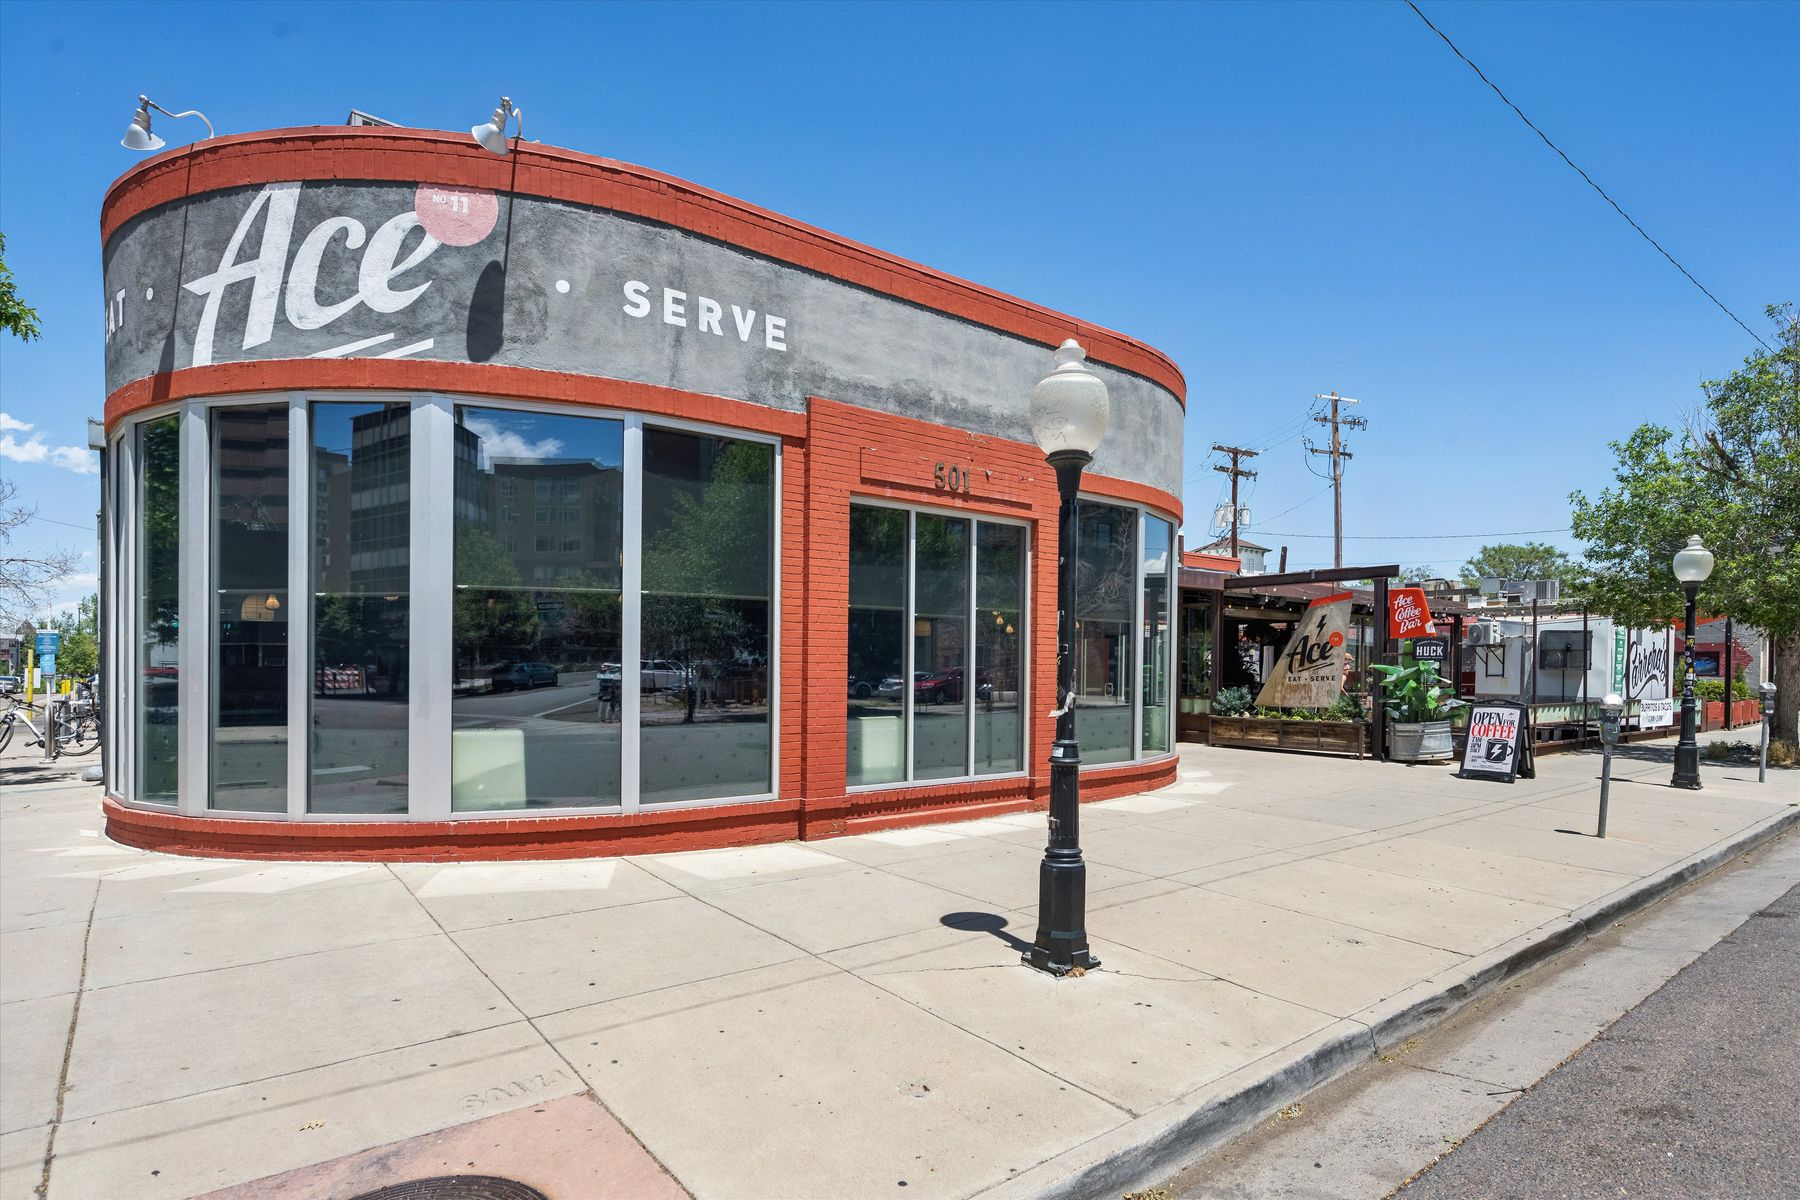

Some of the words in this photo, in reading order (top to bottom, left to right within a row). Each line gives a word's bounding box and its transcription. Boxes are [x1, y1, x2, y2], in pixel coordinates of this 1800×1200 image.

[450, 195, 469, 214] 11
[182, 181, 441, 367] Ace
[622, 280, 787, 351] SERVE
[934, 462, 970, 494] 501
[1393, 594, 1414, 610] Ace
[1395, 605, 1421, 623] Coffee
[1400, 618, 1422, 634] Bar
[1286, 635, 1335, 674] Ace
[1416, 646, 1444, 656] HUCK
[1473, 711, 1504, 726] OPEN
[1503, 719, 1516, 728] FOR
[1471, 724, 1516, 739] COFFEE
